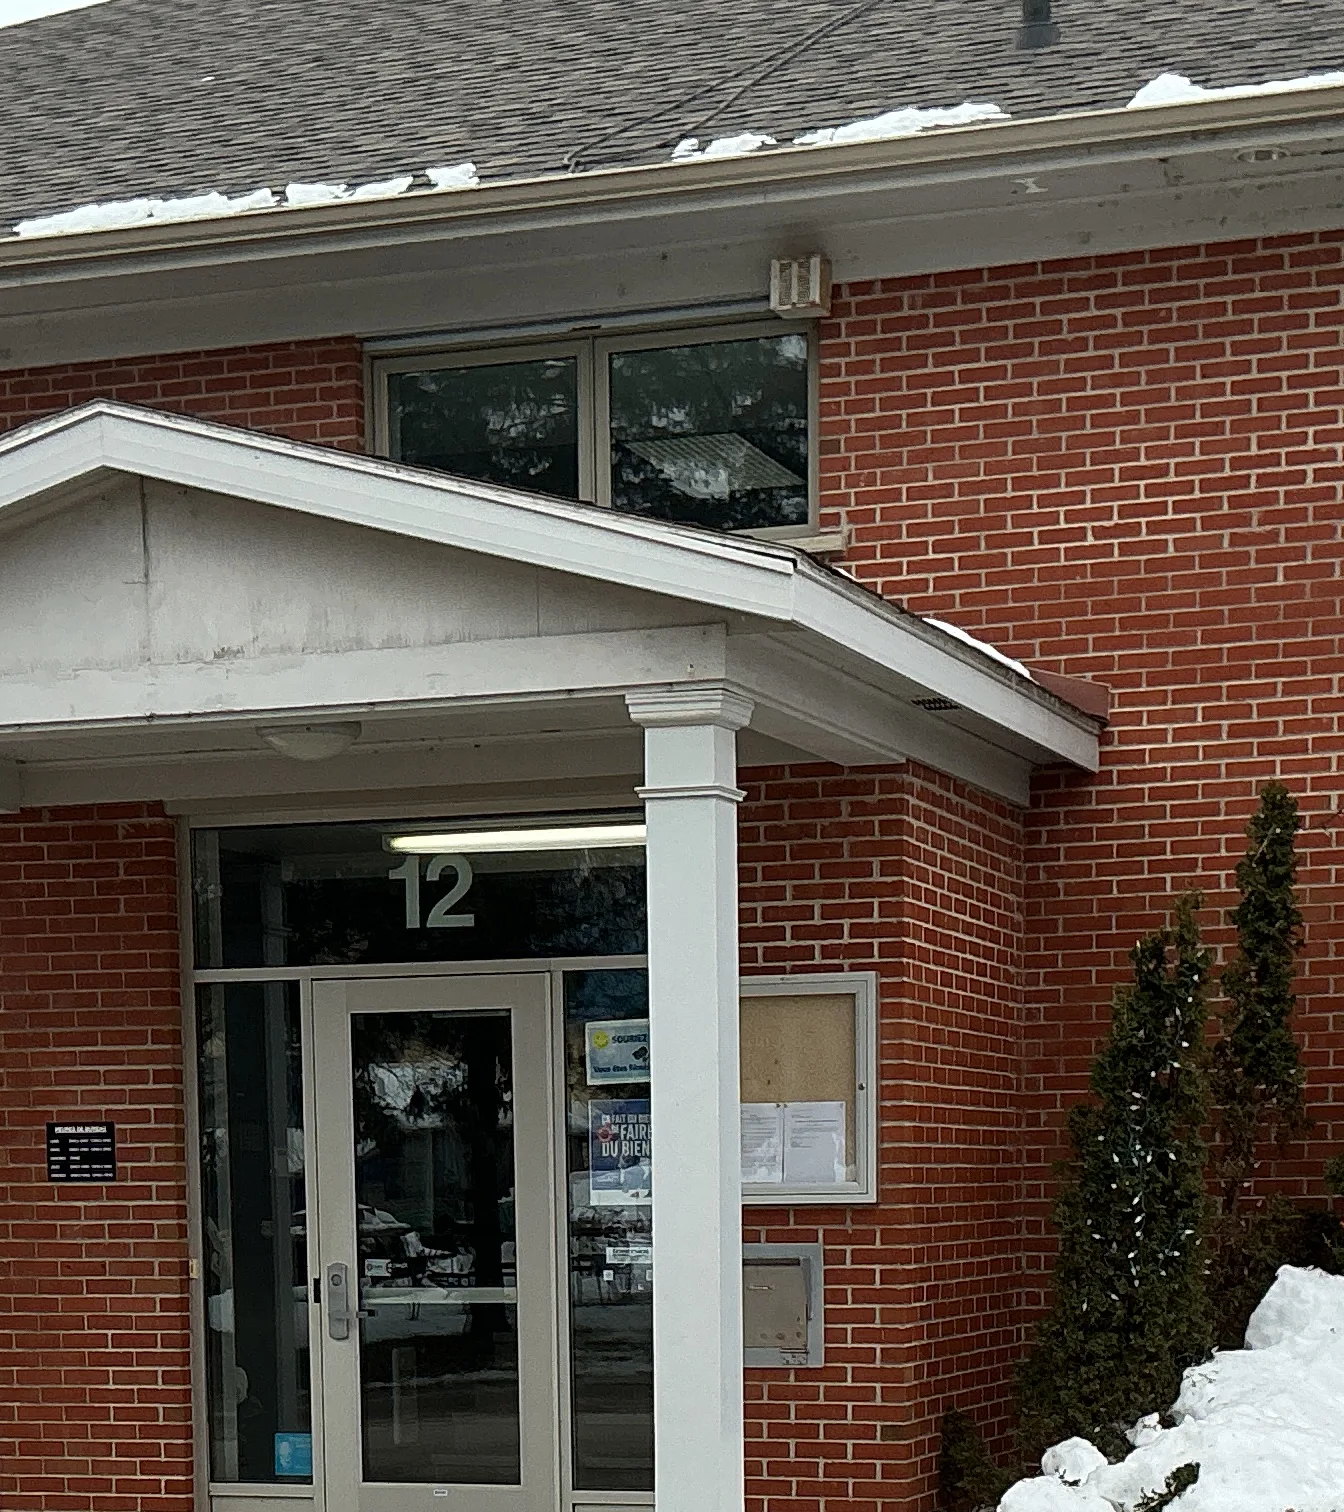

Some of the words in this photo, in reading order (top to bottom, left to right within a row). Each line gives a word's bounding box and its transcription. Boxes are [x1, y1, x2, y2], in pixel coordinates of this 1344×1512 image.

[388, 854, 475, 929] 12
[602, 1141, 618, 1158] DU
[621, 1140, 651, 1157] BIEN
